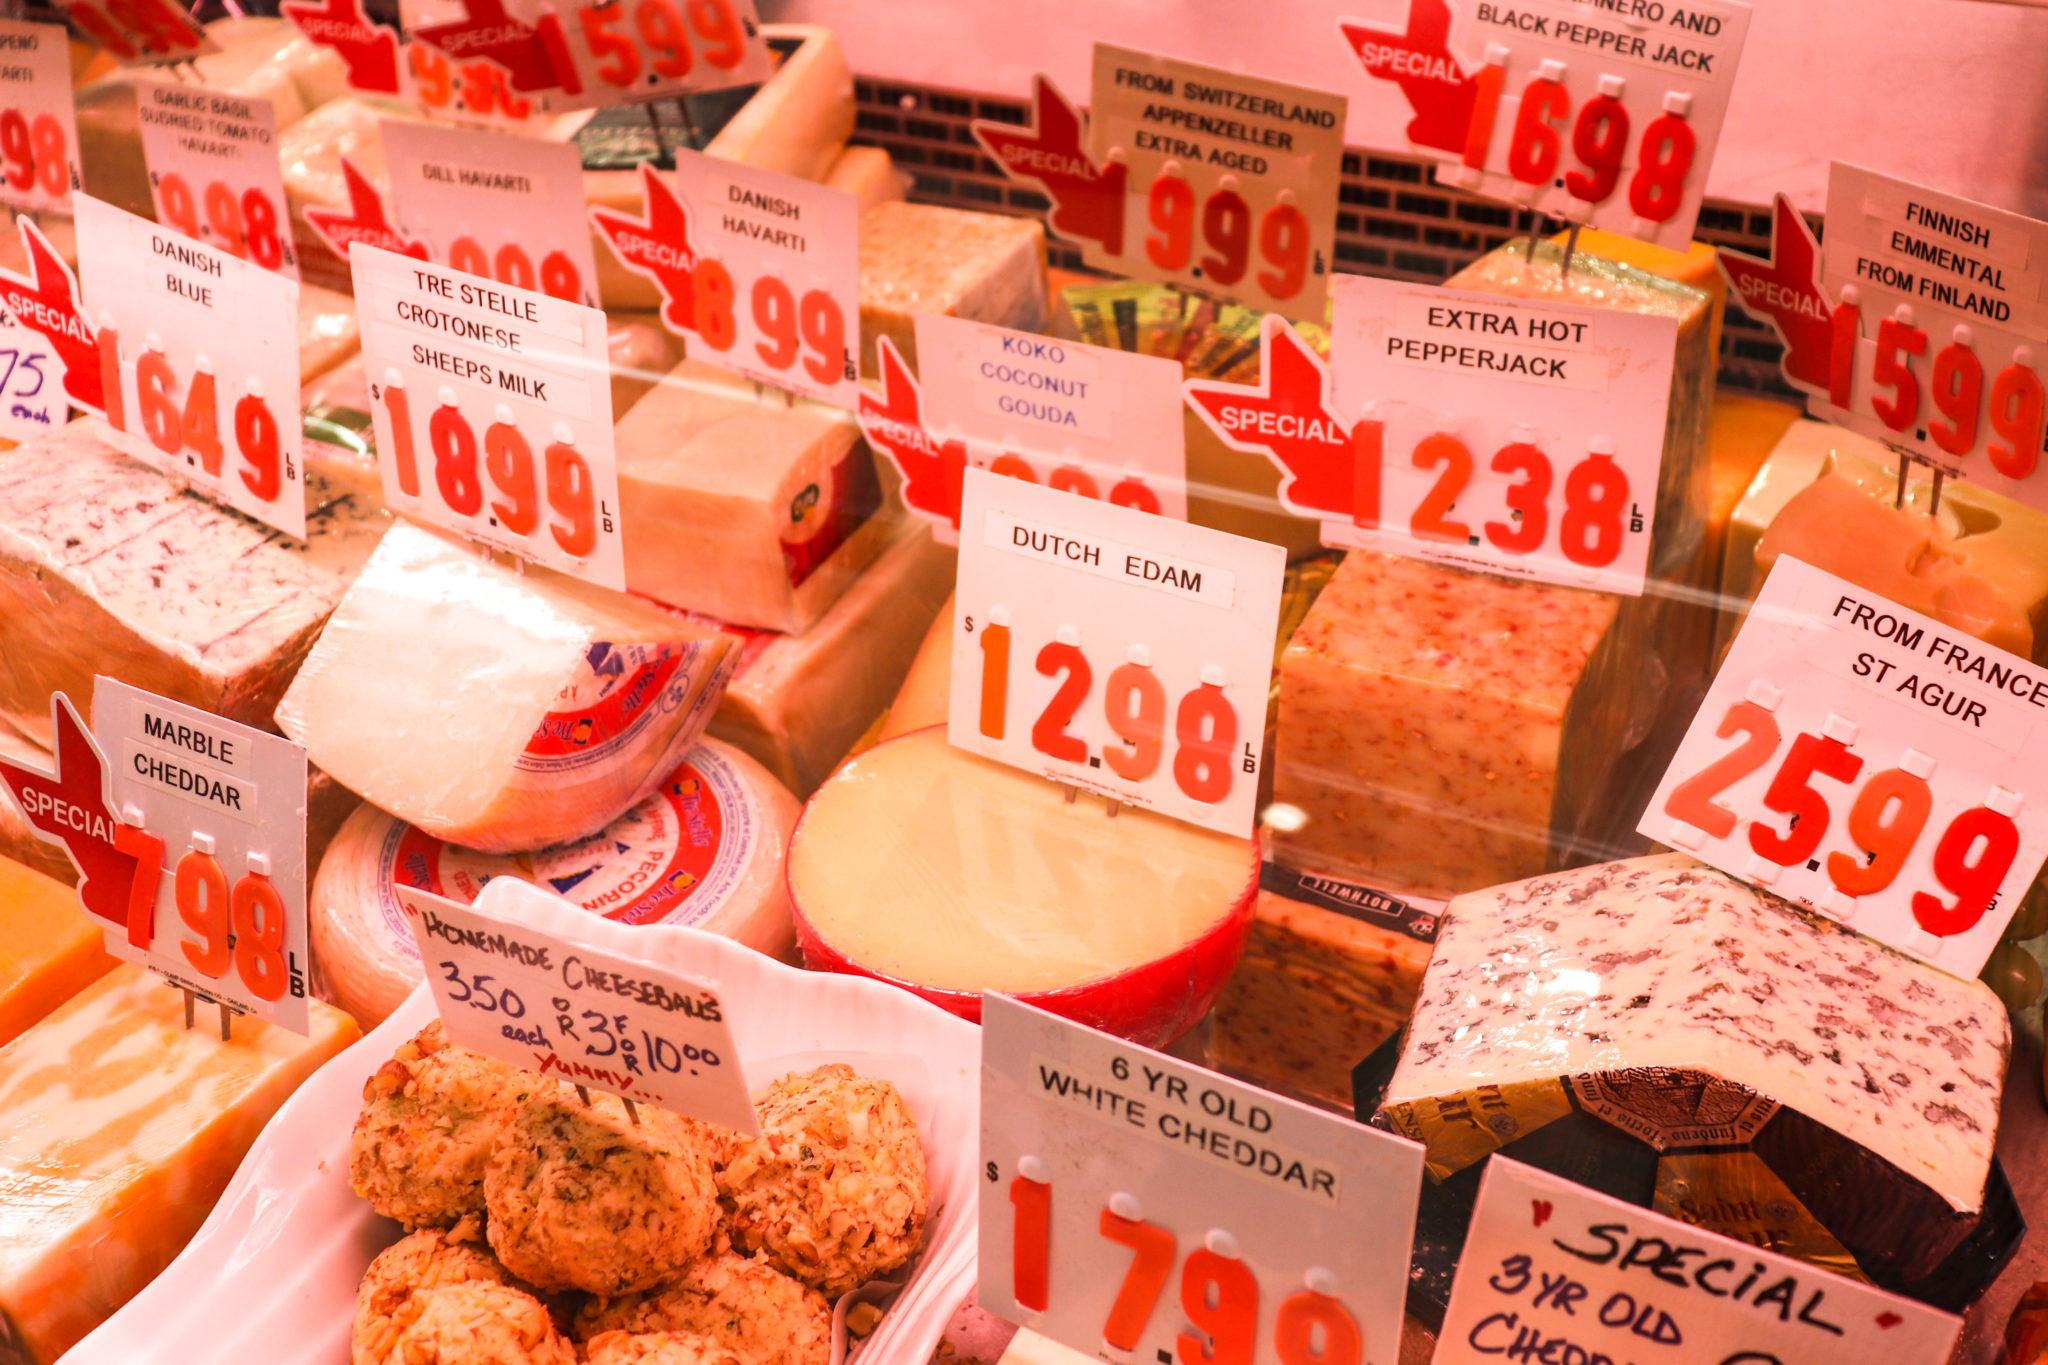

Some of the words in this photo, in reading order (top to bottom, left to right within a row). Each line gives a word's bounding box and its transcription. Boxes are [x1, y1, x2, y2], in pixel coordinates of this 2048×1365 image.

[301, 16, 377, 42] SPECIAL
[440, 22, 536, 51] SPECIAL
[1478, 3, 1550, 36] BLACK
[1556, 21, 1647, 58] PEPPER
[1652, 43, 1715, 73] JACK
[1670, 9, 1721, 36] AND
[0, 65, 34, 82] ARTI
[1361, 42, 1462, 84] SPECIAL
[1115, 68, 1174, 96] FROM
[1183, 82, 1336, 130] SWITZERLAND
[1142, 103, 1294, 151] APPENZELLER
[1001, 144, 1097, 182] SPECIAL
[1135, 130, 1203, 161] EXTRA
[1208, 149, 1268, 175] AGED
[422, 163, 455, 184] DILL
[459, 168, 531, 194] HAVARTI
[729, 185, 800, 220] DANISH
[722, 214, 806, 252] HAVARTI
[1906, 202, 1990, 249] FINNISH
[152, 235, 222, 278] DANISH
[1891, 230, 2006, 291] EMMENTAL
[166, 273, 213, 308] BLUE
[413, 270, 453, 299] TRE
[460, 283, 539, 323] STELLE
[1739, 273, 1828, 322] SPECIAL
[1856, 257, 1914, 293] FROM
[1918, 276, 2011, 322] FINLAND
[8, 291, 93, 345] SPECIAL
[397, 301, 522, 354] CROTONESE
[1427, 307, 1519, 337] EXTRA
[1528, 318, 1588, 344] HOT
[1002, 335, 1065, 364] KOKO
[1386, 336, 1568, 380] PEPPERJACK
[371, 384, 380, 400] $
[412, 344, 493, 385] SHEEPS
[499, 370, 548, 402] MILK
[980, 361, 1088, 400] COCONUT
[862, 406, 939, 457] SPECIAL
[998, 394, 1078, 427] GOUDA
[1219, 406, 1345, 445] SPECIAL
[286, 452, 296, 480] LB
[601, 500, 614, 533] LB
[1629, 503, 1644, 534] LB
[1012, 525, 1101, 567] DUTCH
[1125, 555, 1202, 593] EDAM
[964, 615, 975, 633] $
[1832, 595, 1925, 652] FROM
[1925, 637, 2048, 708] FRANCE
[1852, 652, 1897, 684] ST
[1896, 674, 1987, 728] AGUR
[144, 712, 234, 765] MARBLE
[1243, 742, 1256, 774] LB
[133, 752, 241, 811] CHEDDAR
[581, 851, 665, 911] PECORIN
[1312, 878, 1392, 912] BOTHWELL
[421, 911, 553, 971] HOMEMADE
[289, 951, 305, 999] LB
[501, 1023, 554, 1050] each
[1111, 1056, 1129, 1081] 6
[1142, 1065, 1189, 1105] YR
[1199, 1088, 1273, 1134] OLD
[1039, 1065, 1147, 1128] WHITE
[1158, 1113, 1336, 1199] CHEDDAR
[985, 1161, 999, 1183] $
[1600, 1292, 1682, 1345] OLD
